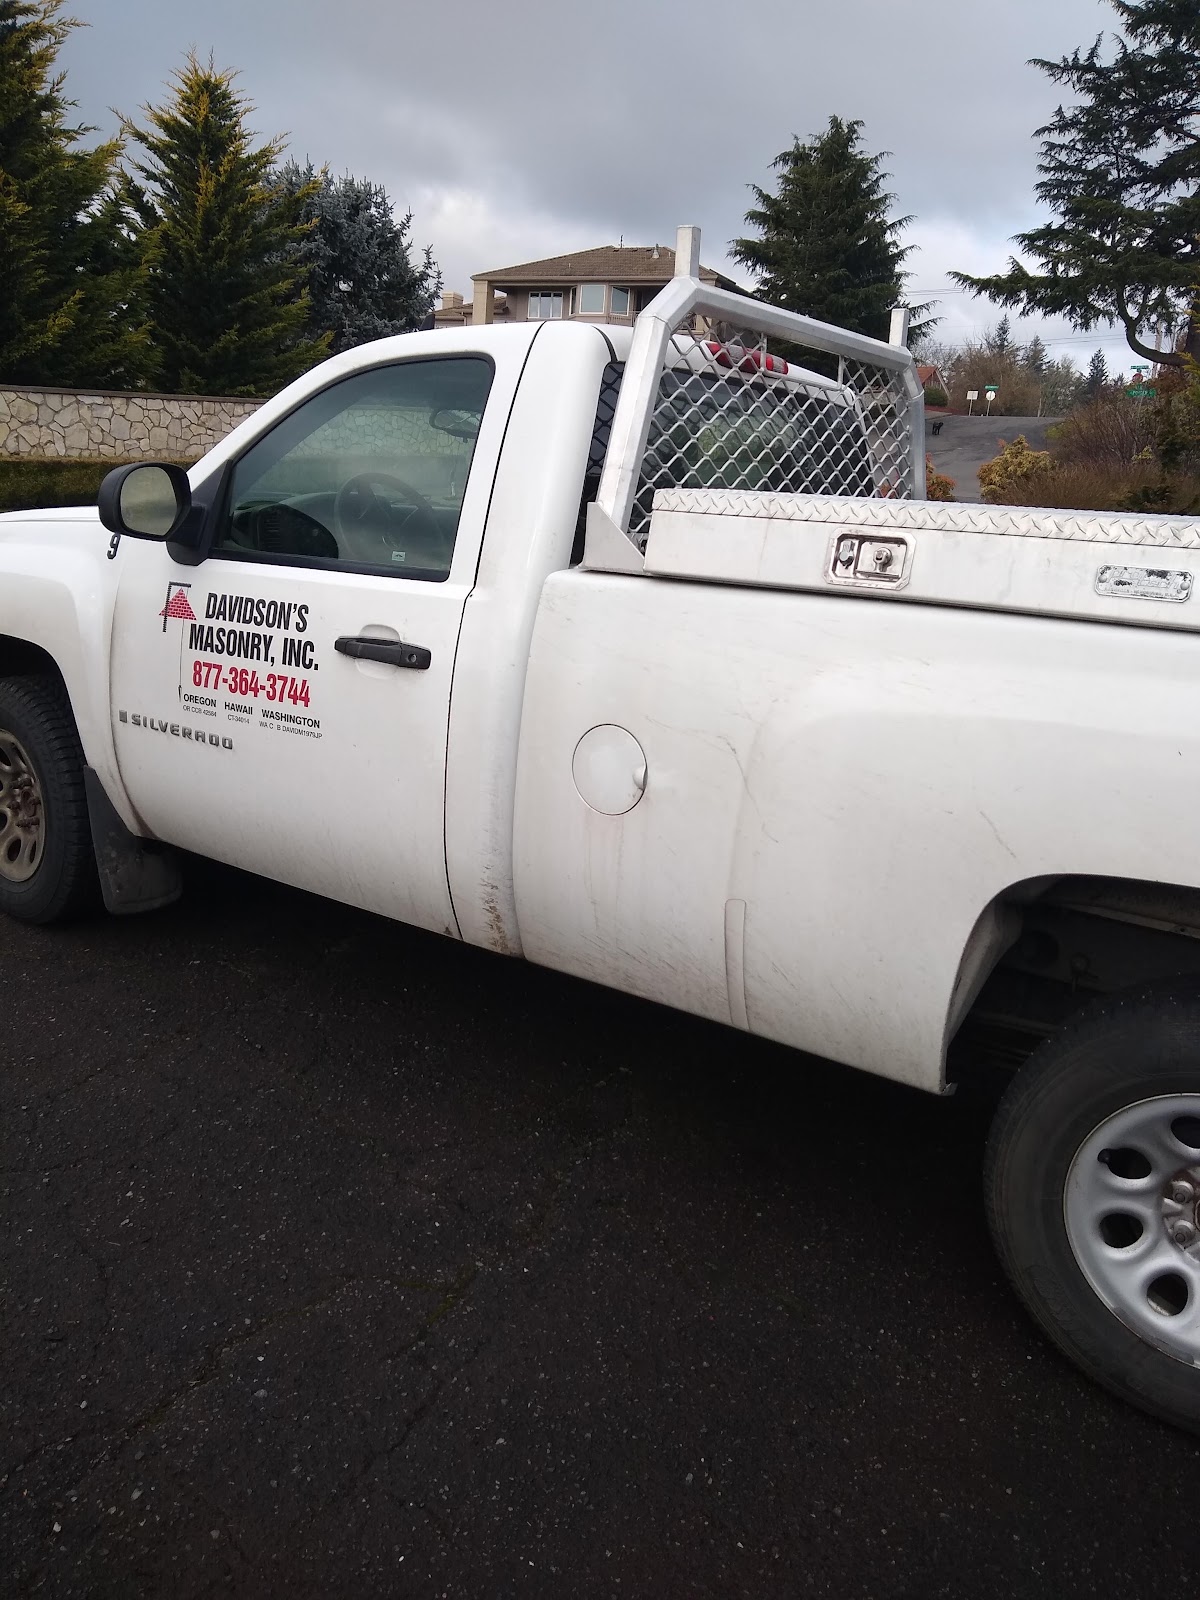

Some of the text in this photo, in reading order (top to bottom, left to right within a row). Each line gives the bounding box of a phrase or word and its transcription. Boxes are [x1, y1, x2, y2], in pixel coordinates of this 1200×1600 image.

[205, 592, 309, 633] DAVIDSON'S
[188, 623, 319, 671] MASONRY, INC.
[192, 660, 311, 708] 877-364-3744
[182, 704, 191, 712] OR
[183, 693, 320, 729] OREGON HAWAII WASHINGTON
[131, 712, 234, 751] SILVERADO
